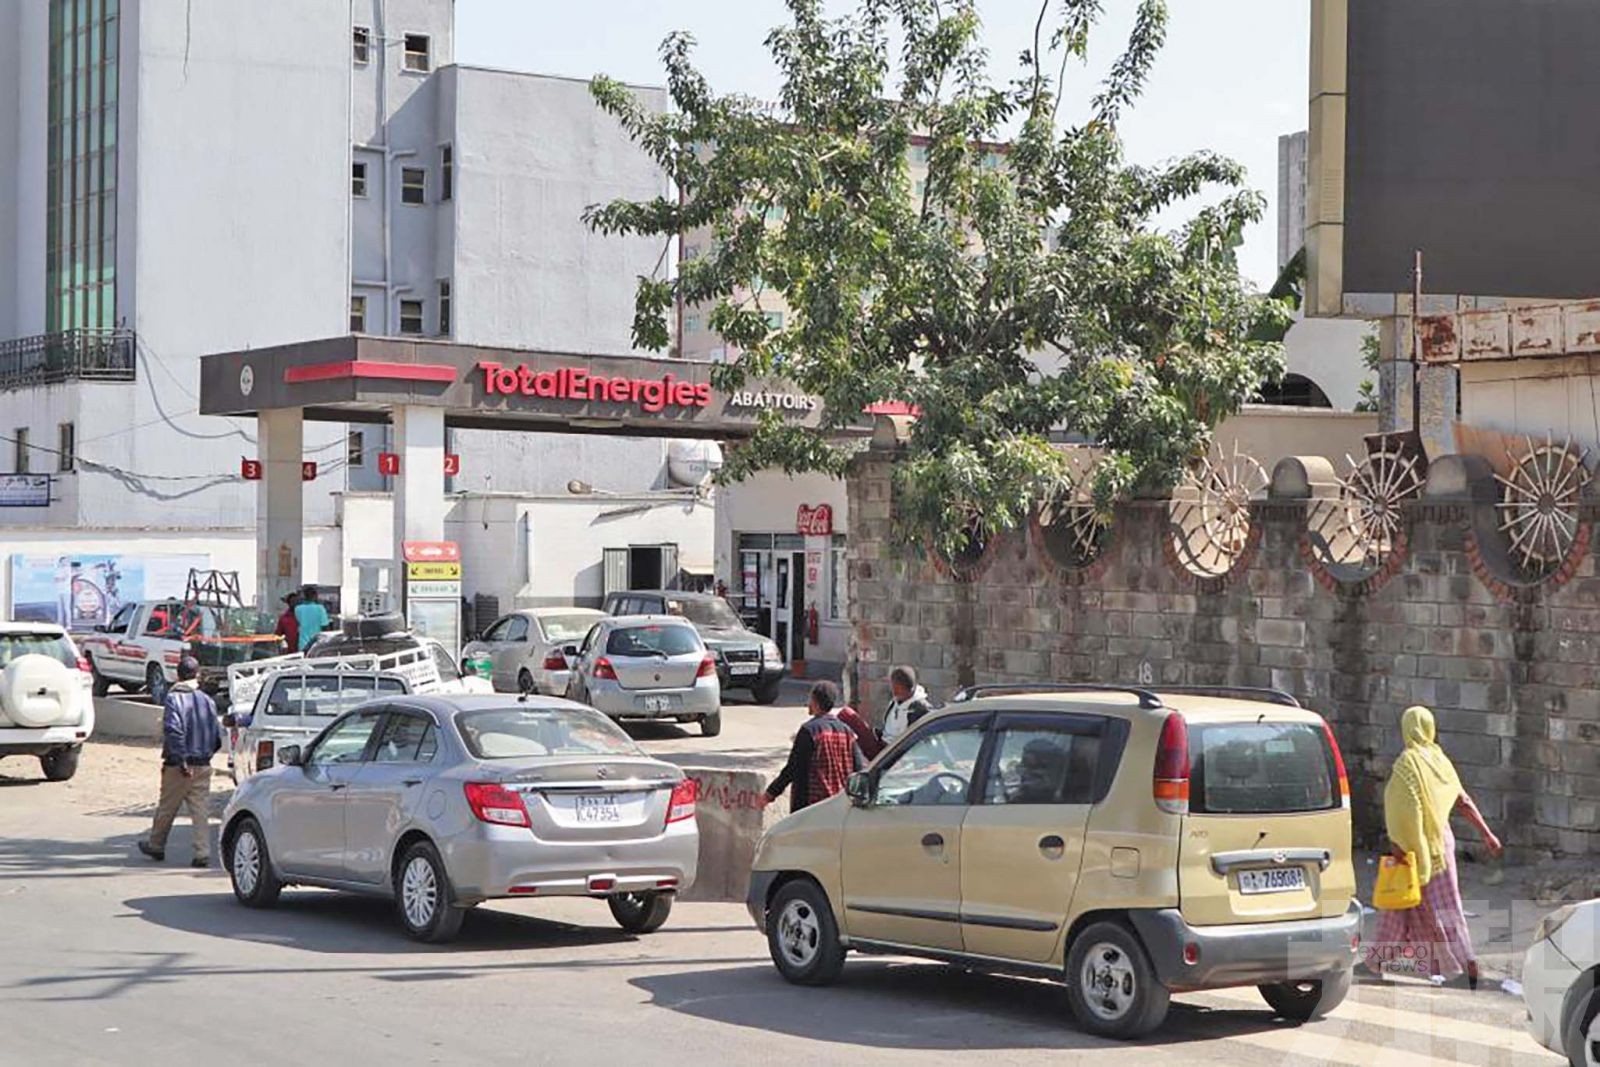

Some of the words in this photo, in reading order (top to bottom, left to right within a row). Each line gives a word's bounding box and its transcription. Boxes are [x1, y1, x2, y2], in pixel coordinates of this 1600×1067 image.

[478, 361, 712, 412] TotalEnergies
[731, 392, 817, 410] ABATTOIRS
[249, 463, 256, 477] 3
[303, 464, 312, 477] 4
[386, 457, 394, 471] 1
[444, 458, 453, 472] 2
[1138, 661, 1153, 685] 18
